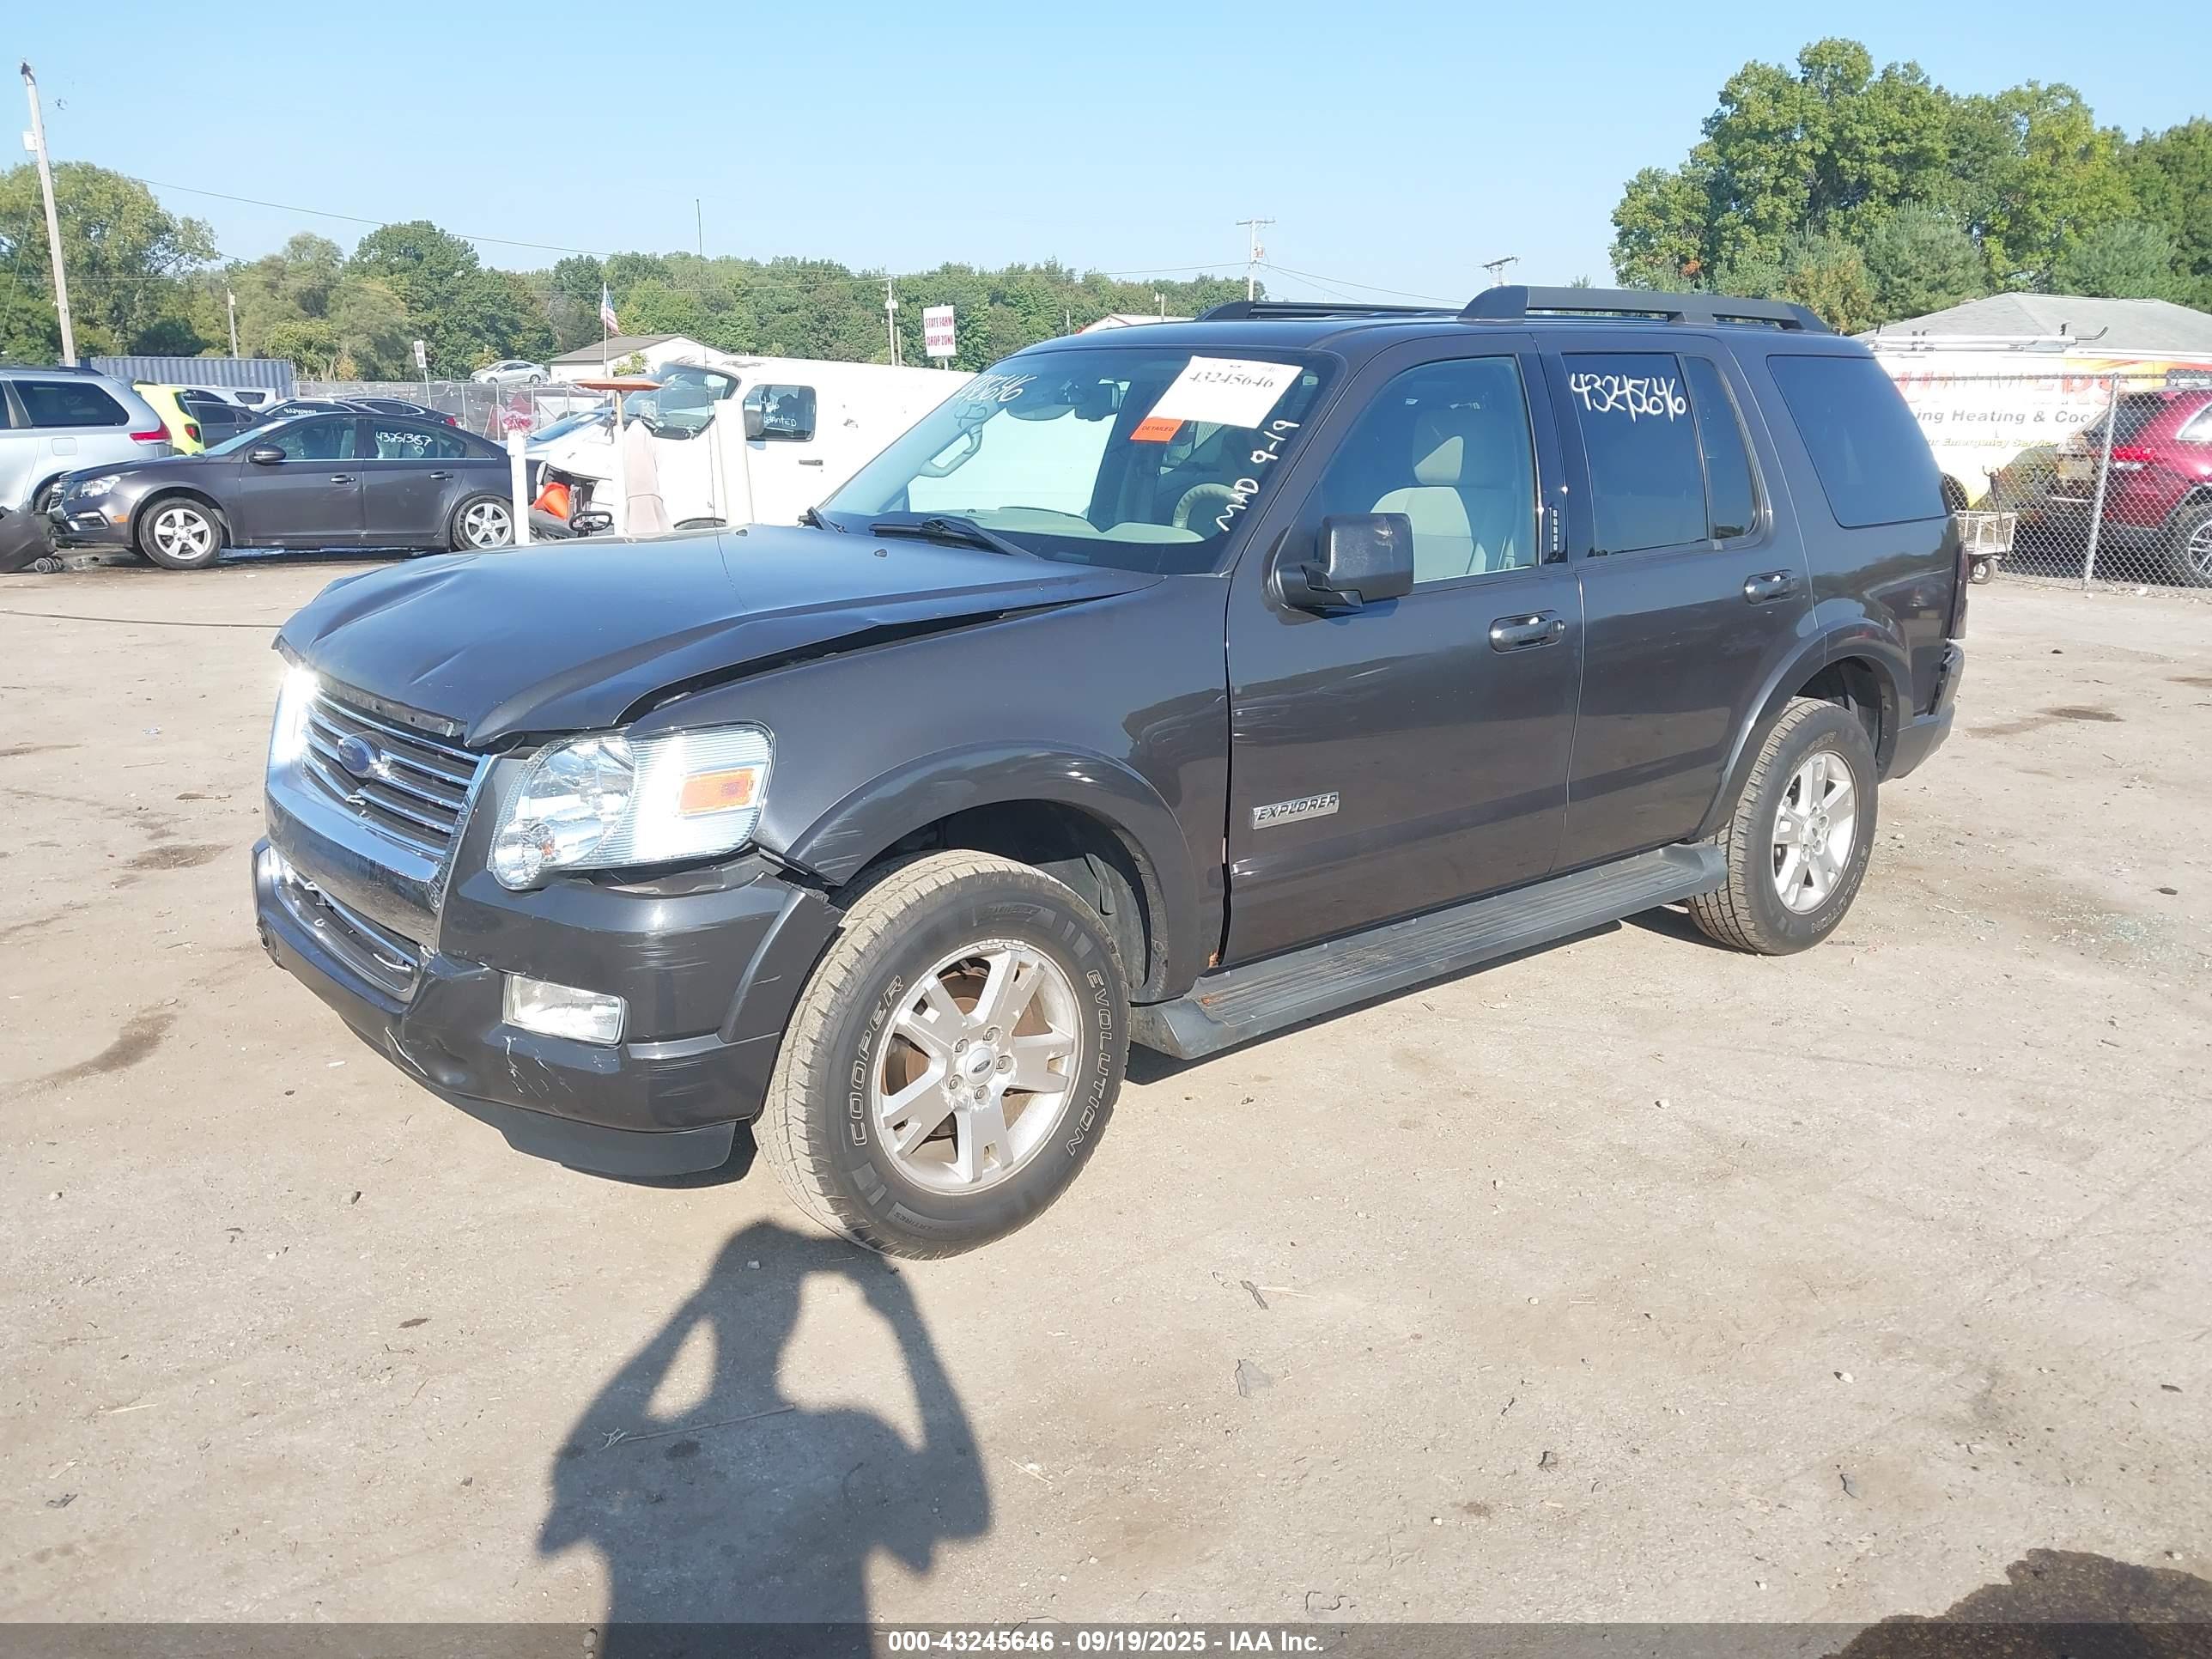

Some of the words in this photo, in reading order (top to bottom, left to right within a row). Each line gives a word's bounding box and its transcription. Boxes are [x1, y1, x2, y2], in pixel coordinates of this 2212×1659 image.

[925, 317, 939, 329] STATE
[939, 315, 953, 327] FARM
[927, 335, 940, 346] DROP
[940, 334, 954, 346] ZONE
[1188, 371, 1274, 388] 43245646
[1571, 373, 1686, 423] 43245646
[1952, 409, 2025, 425] Heating
[2033, 410, 2045, 422] &
[1141, 424, 1175, 433] DETAILED
[375, 431, 434, 447] 43251387
[1216, 477, 1259, 532] MAD
[1257, 794, 1337, 821] EXPLORER
[849, 975, 904, 1146] COOPER
[1066, 969, 1113, 1157] EVOLUTION
